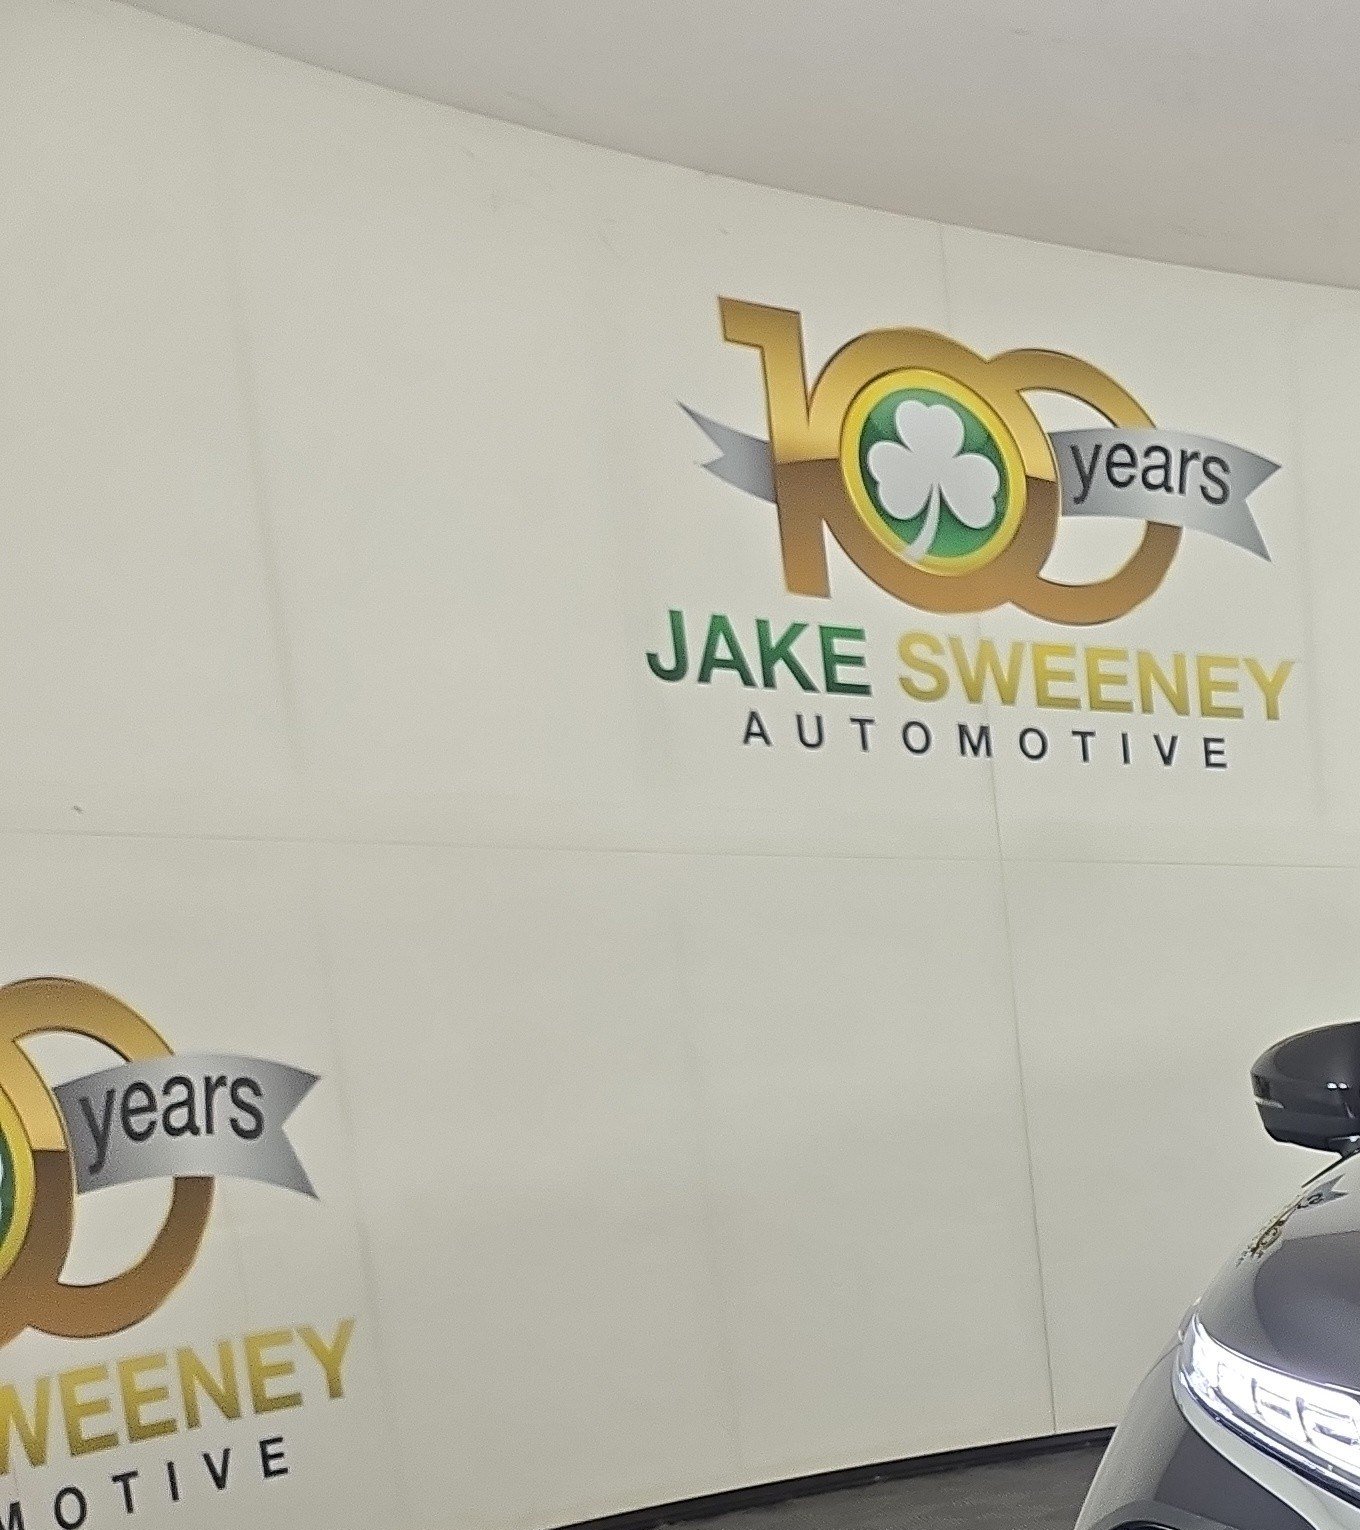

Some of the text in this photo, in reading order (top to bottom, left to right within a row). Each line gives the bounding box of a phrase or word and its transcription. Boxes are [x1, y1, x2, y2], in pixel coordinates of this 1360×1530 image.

[717, 295, 1183, 627] 100
[1069, 439, 1232, 505] years
[646, 609, 1296, 721] JAKE SWEENEY
[742, 710, 1229, 770] AUTOMOTIVE
[77, 1072, 266, 1175] years
